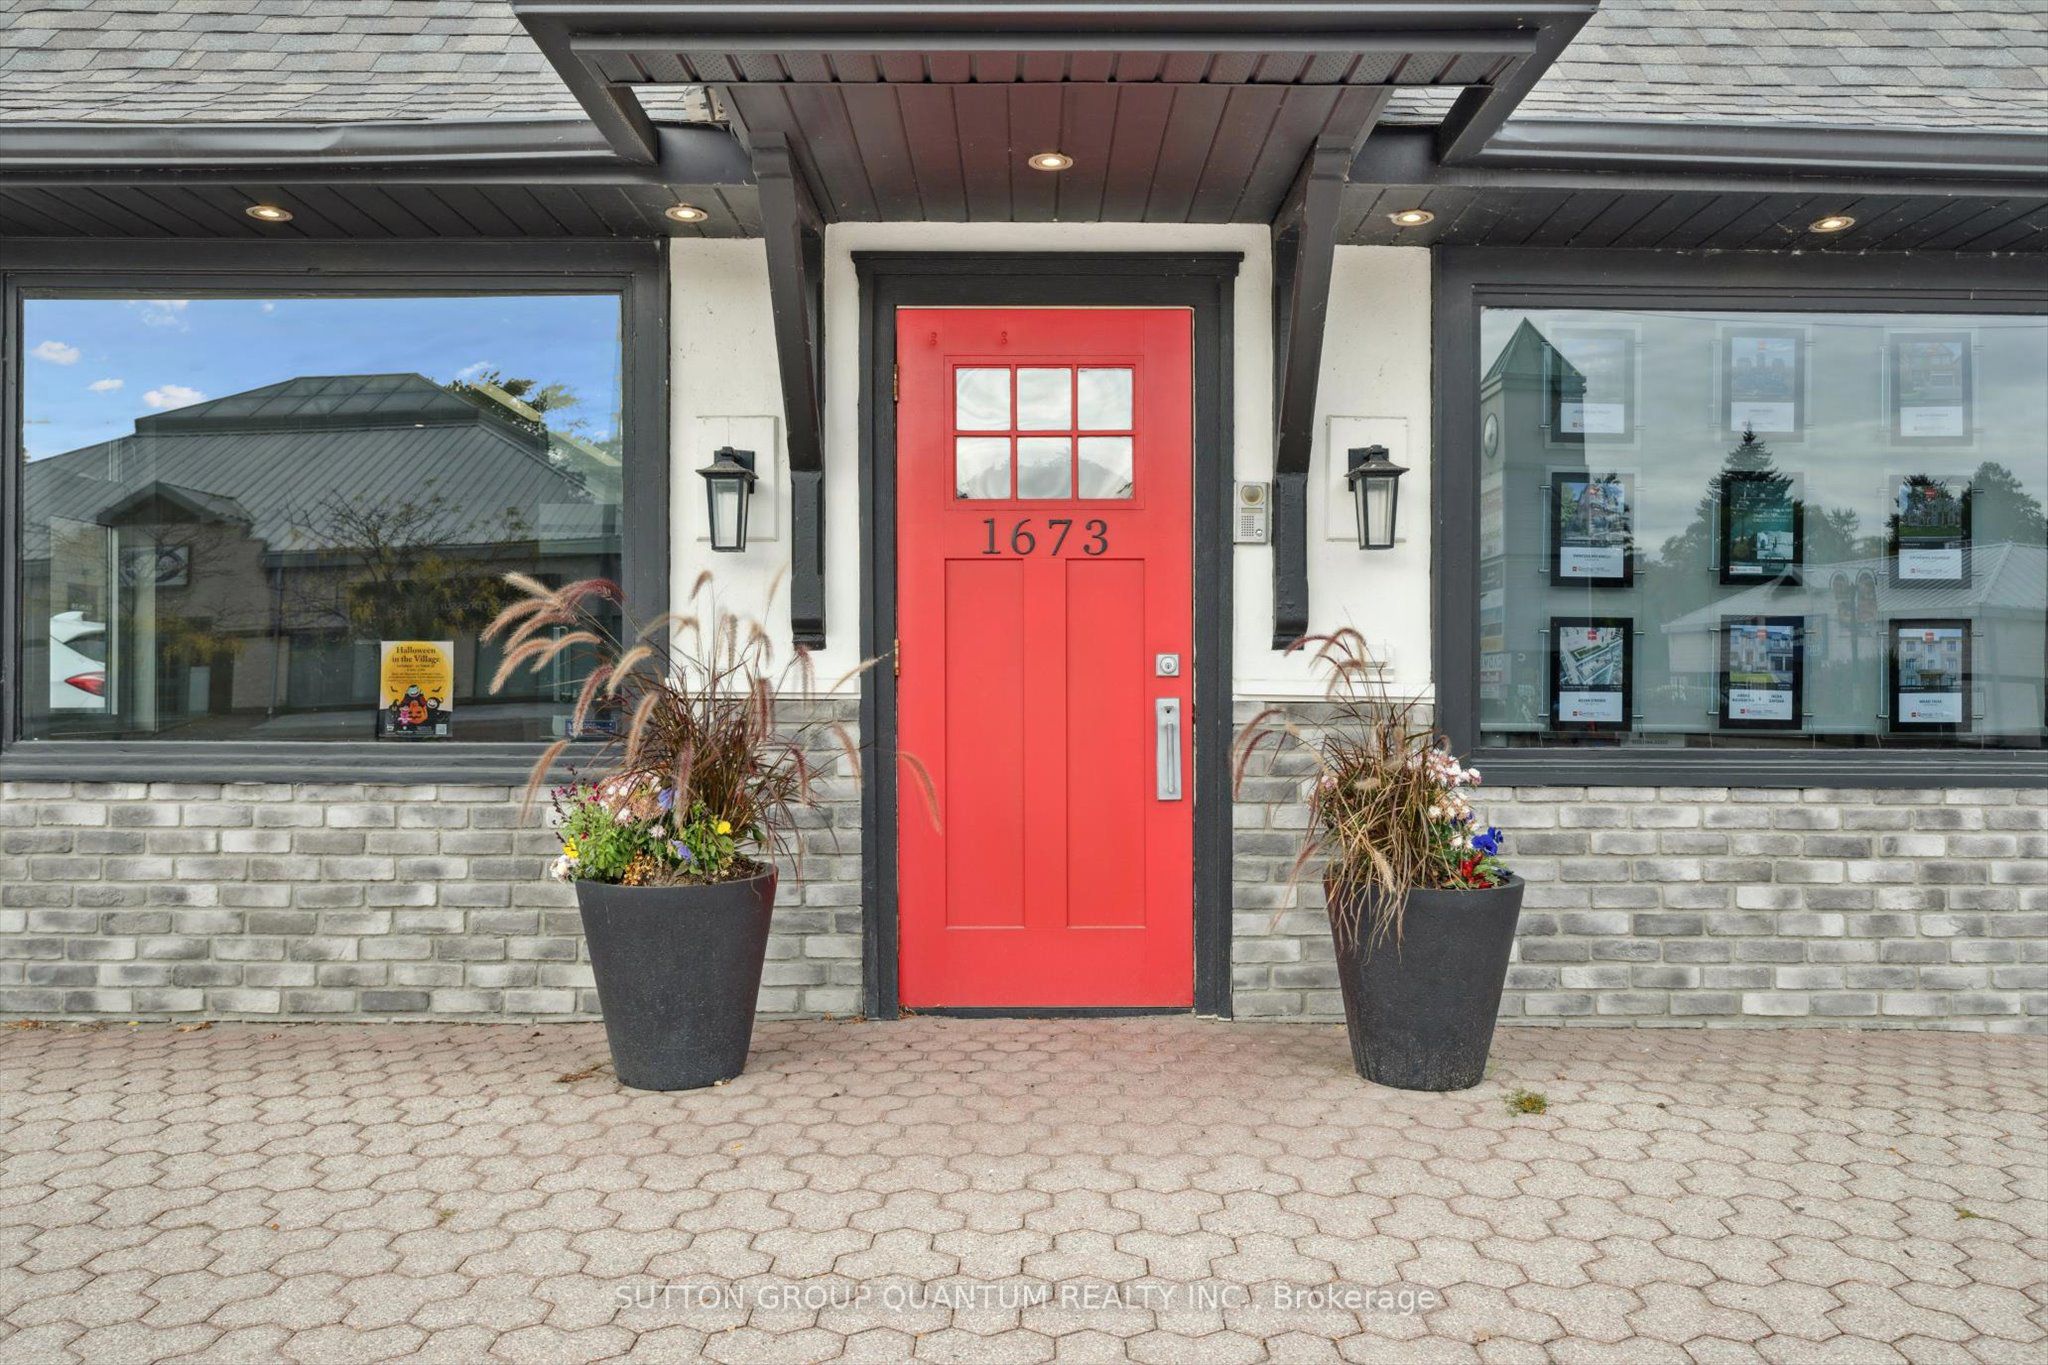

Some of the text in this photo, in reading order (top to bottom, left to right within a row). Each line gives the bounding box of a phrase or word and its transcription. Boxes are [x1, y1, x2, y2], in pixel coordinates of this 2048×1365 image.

[982, 517, 1108, 556] 1673
[396, 646, 436, 654] Halloween
[414, 654, 440, 664] Village
